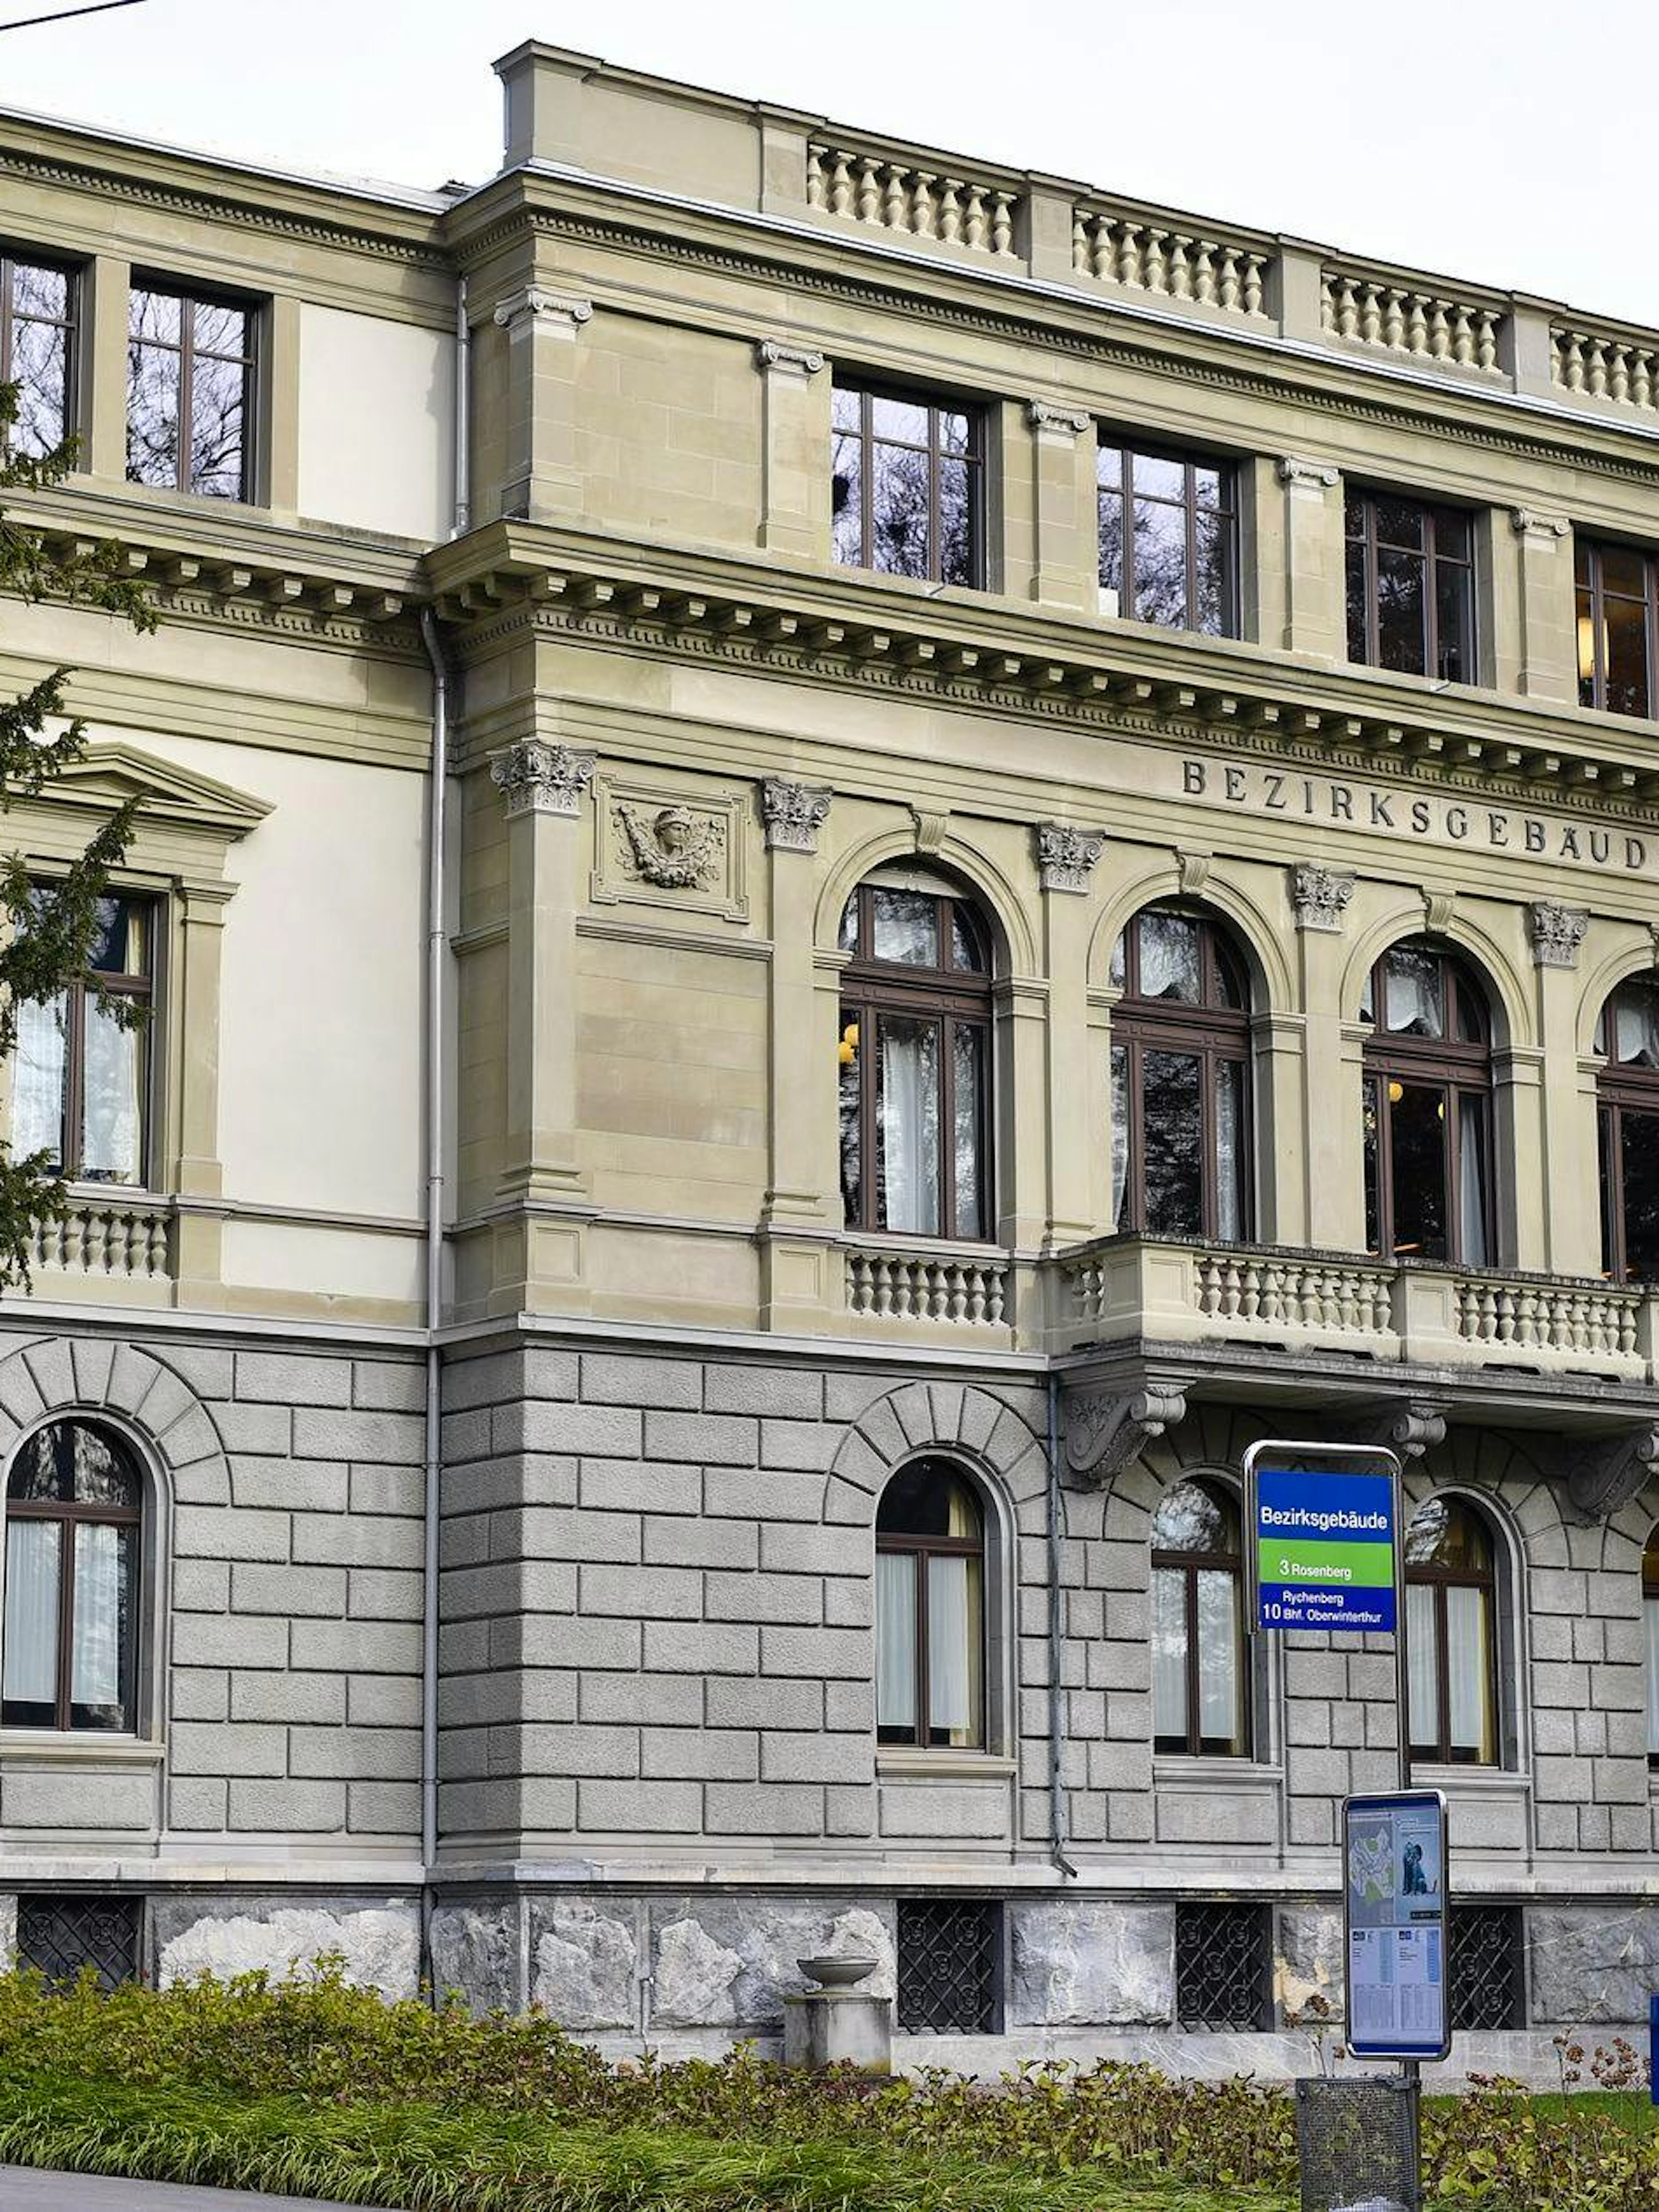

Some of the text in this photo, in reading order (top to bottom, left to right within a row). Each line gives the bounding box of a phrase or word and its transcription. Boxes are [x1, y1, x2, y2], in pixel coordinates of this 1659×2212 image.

[1181, 760, 1646, 869] BEZIRKSGEBÄUD
[1261, 1505, 1388, 1532] Bezirksgebäude
[1279, 1559, 1352, 1581] 3 Rosenberg
[1282, 1590, 1344, 1607] Rychenberg
[1263, 1603, 1382, 1623] 10 Bhf. Oberwinterthur
